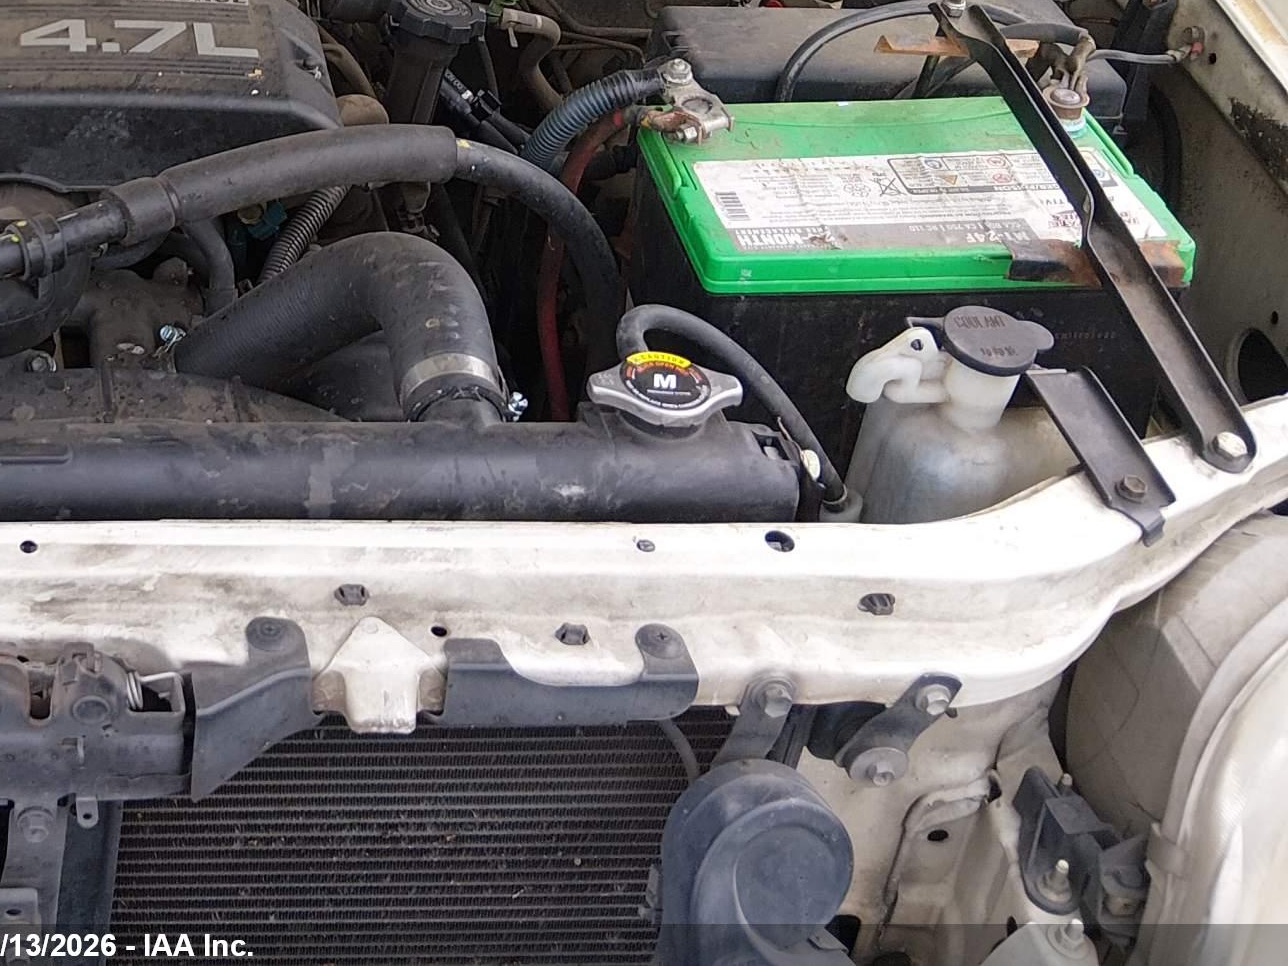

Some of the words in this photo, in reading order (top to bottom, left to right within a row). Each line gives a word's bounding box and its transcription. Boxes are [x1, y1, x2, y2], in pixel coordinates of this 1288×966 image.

[20, 18, 260, 59] 4.7L
[953, 315, 1006, 329] COOLANT
[653, 373, 677, 389] M
